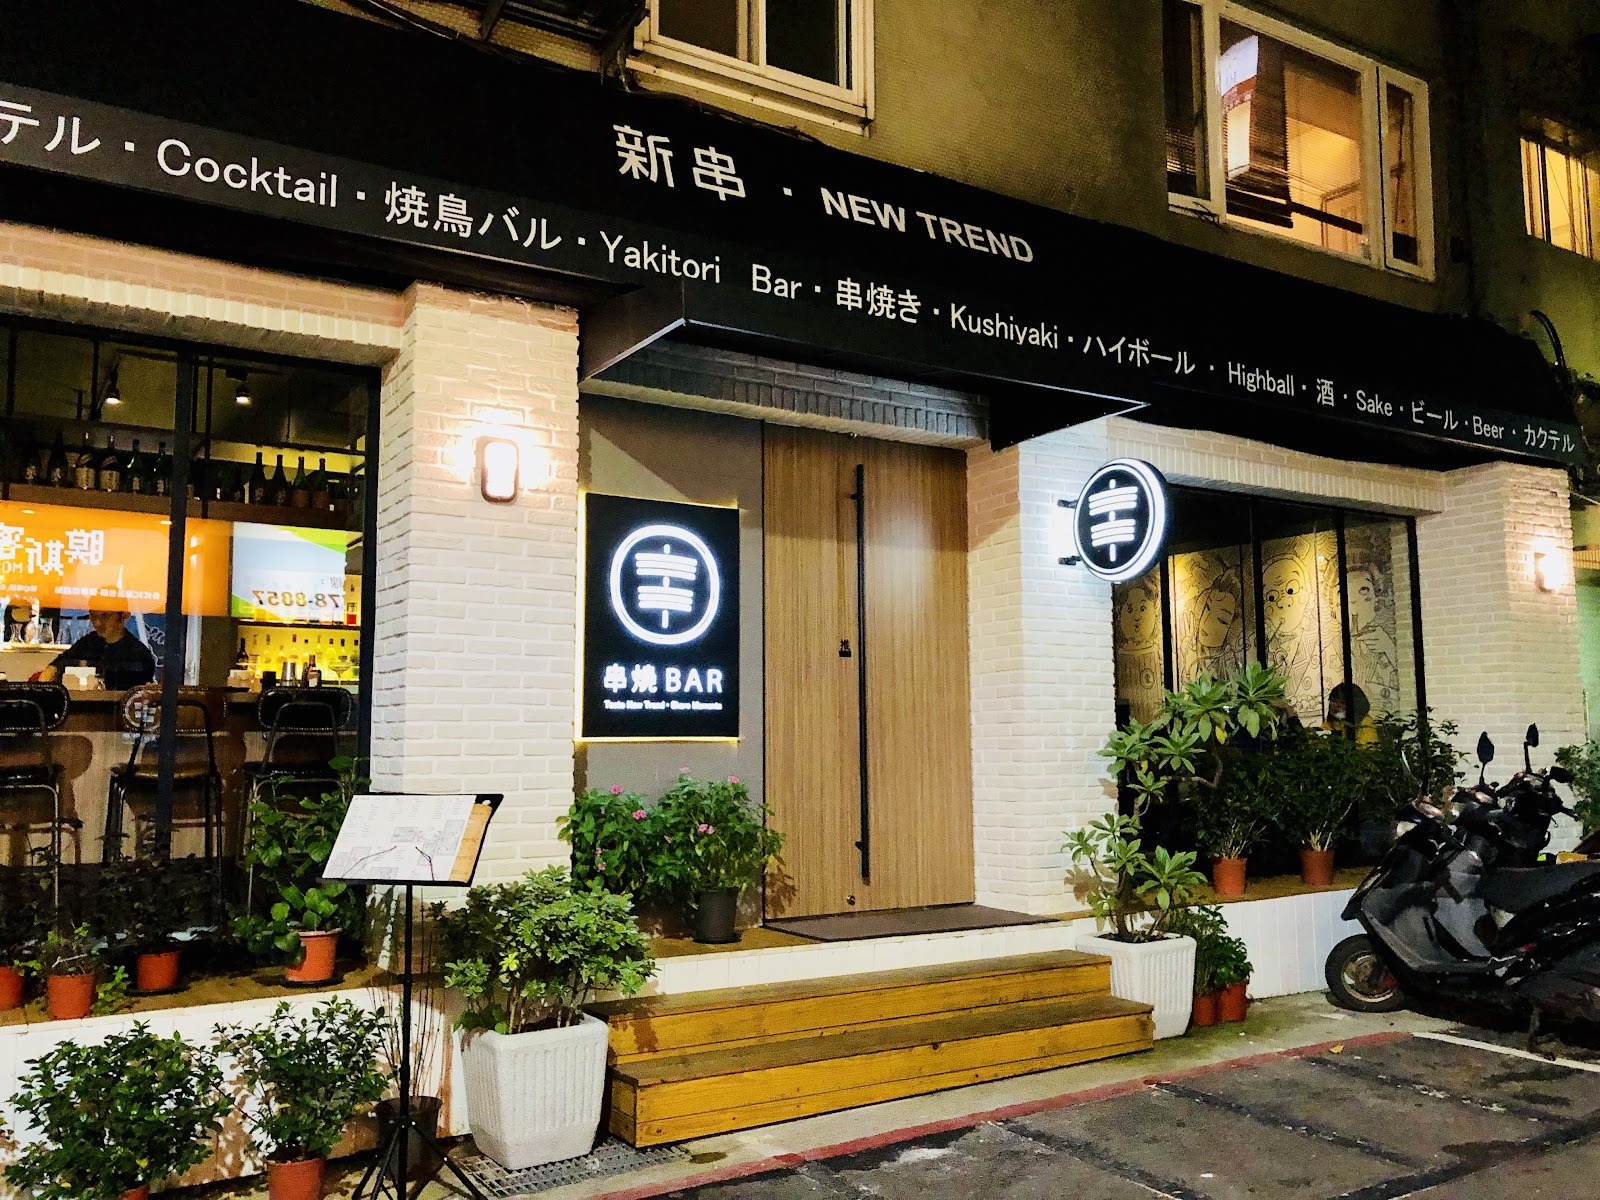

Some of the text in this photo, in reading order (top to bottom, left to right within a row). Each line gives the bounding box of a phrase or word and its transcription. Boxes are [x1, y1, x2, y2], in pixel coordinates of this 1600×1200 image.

[612, 124, 746, 202] 新串
[820, 187, 1034, 263] NEW TREND
[0, 101, 1575, 453] テル Cocktail 焼鳥バル Yakitori Bar 串焼き Kushiyaki ハイボール Highball 酒 Sake ビール Beer カクテル
[664, 666, 723, 694] BAR
